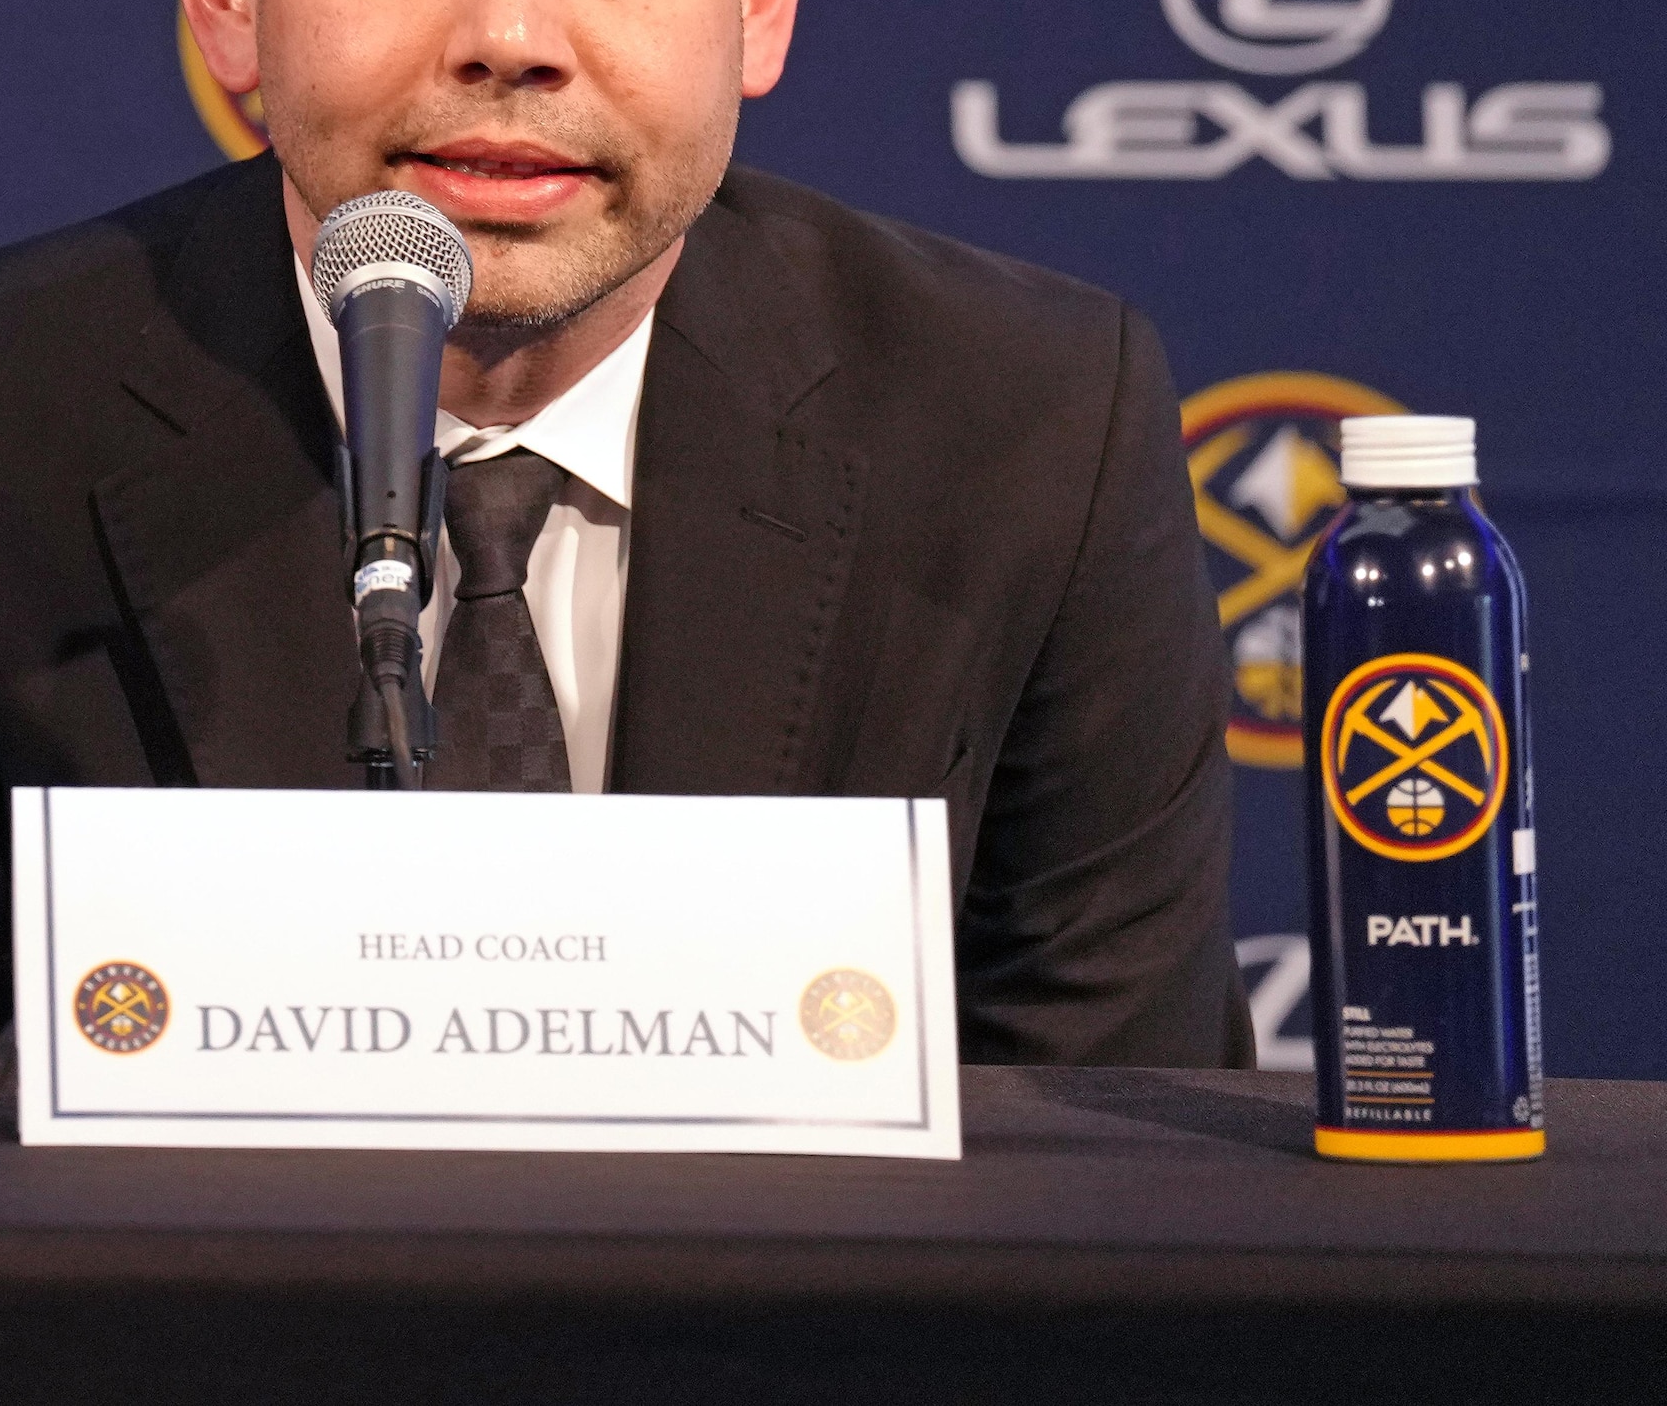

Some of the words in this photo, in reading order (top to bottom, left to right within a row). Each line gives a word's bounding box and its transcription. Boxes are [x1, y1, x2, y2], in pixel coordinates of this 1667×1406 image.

[951, 81, 1612, 179] LEXUS
[359, 934, 465, 961] HEAD
[474, 935, 607, 963] COACH
[196, 1004, 413, 1054] DAVID
[434, 1007, 777, 1057] ADELMAN
